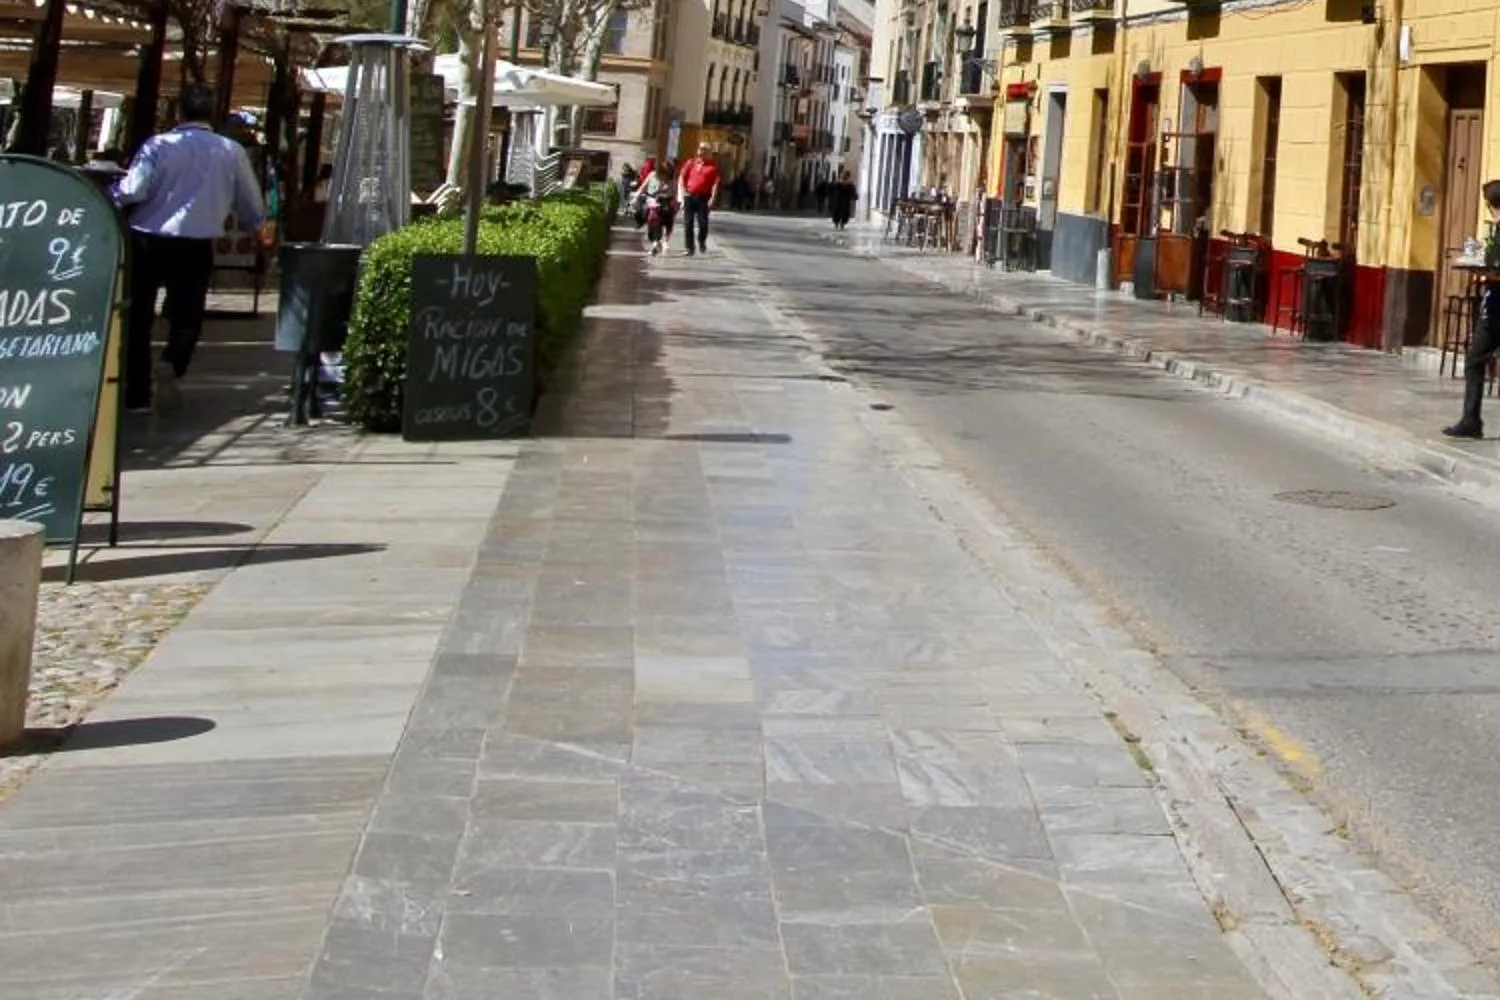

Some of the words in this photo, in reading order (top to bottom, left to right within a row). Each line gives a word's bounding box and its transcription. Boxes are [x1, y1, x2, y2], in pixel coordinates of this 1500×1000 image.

[0, 200, 48, 229] TO
[57, 207, 86, 226] DE
[428, 343, 524, 383] MIGAS
[3, 421, 24, 453] 2
